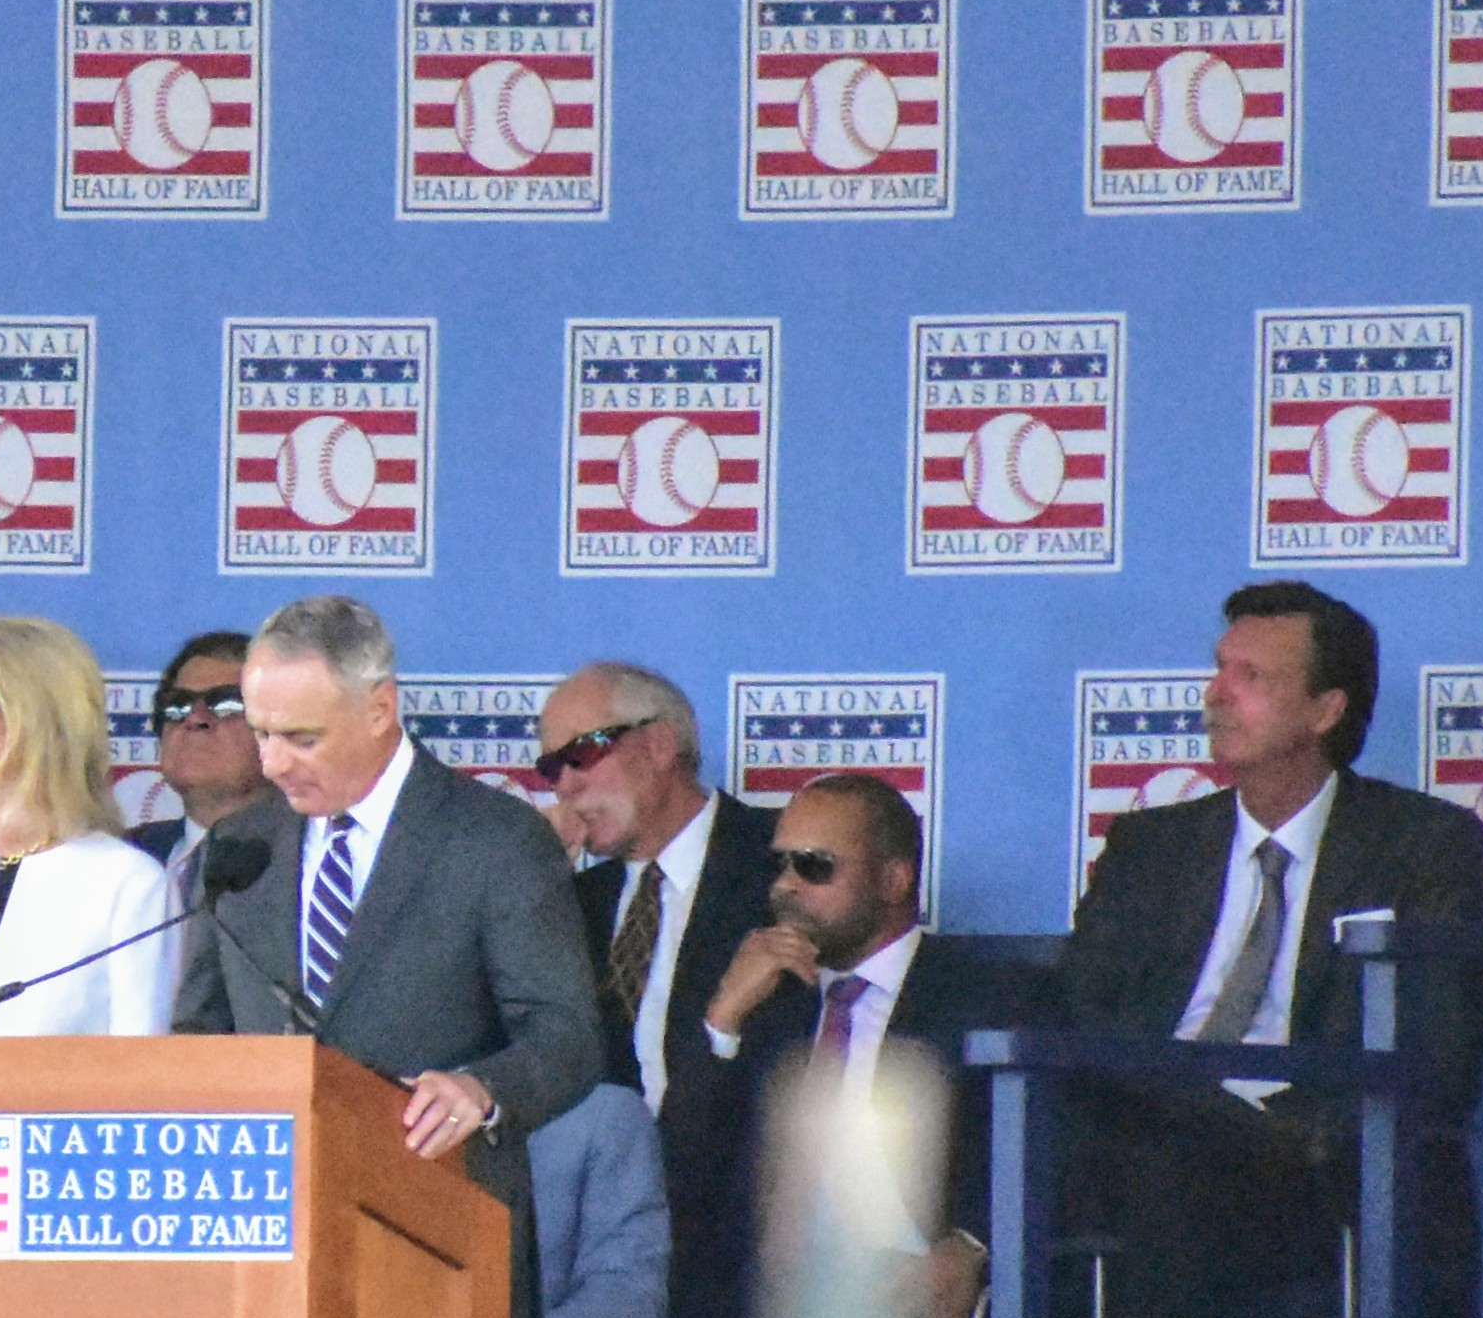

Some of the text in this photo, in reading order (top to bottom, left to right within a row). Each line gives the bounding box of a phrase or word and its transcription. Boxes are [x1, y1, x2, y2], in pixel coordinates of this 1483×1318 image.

[74, 29, 252, 51] BASEBALL
[415, 30, 595, 52] BASEBALL
[758, 27, 940, 51] BASEBALL
[1103, 18, 1285, 45] BASEBALL
[72, 178, 252, 200] HALL OF FAME
[412, 180, 594, 201] HALL OF FAME
[755, 177, 939, 201] HALL OF FAME
[1100, 169, 1285, 195] HALL OF FAME
[239, 333, 420, 355] NATIONAL
[581, 333, 763, 356] NATIONAL
[926, 328, 1108, 353] NATIONAL
[1271, 320, 1453, 346] NATIONAL
[238, 385, 419, 407] BASEBALL
[580, 386, 762, 408] BASEBALL
[925, 380, 1107, 406] BASEBALL
[1271, 373, 1453, 399] BASEBALL
[7, 533, 75, 554] FAME
[234, 534, 416, 556] HALL OF FAME
[575, 535, 759, 557] HALL OF FAME
[921, 531, 1105, 556] HALL OF FAME
[1266, 524, 1450, 549] HALL OF FAME
[403, 690, 537, 711] NATION
[745, 687, 927, 712] NATIONAL
[1091, 682, 1201, 709] NATIO
[745, 740, 927, 765] BASEBALL
[1091, 735, 1201, 762] BASEB
[26, 1124, 288, 1154] NATIONAL
[26, 1169, 288, 1200] BASEBALL
[25, 1214, 287, 1246] HALL OF FAME
